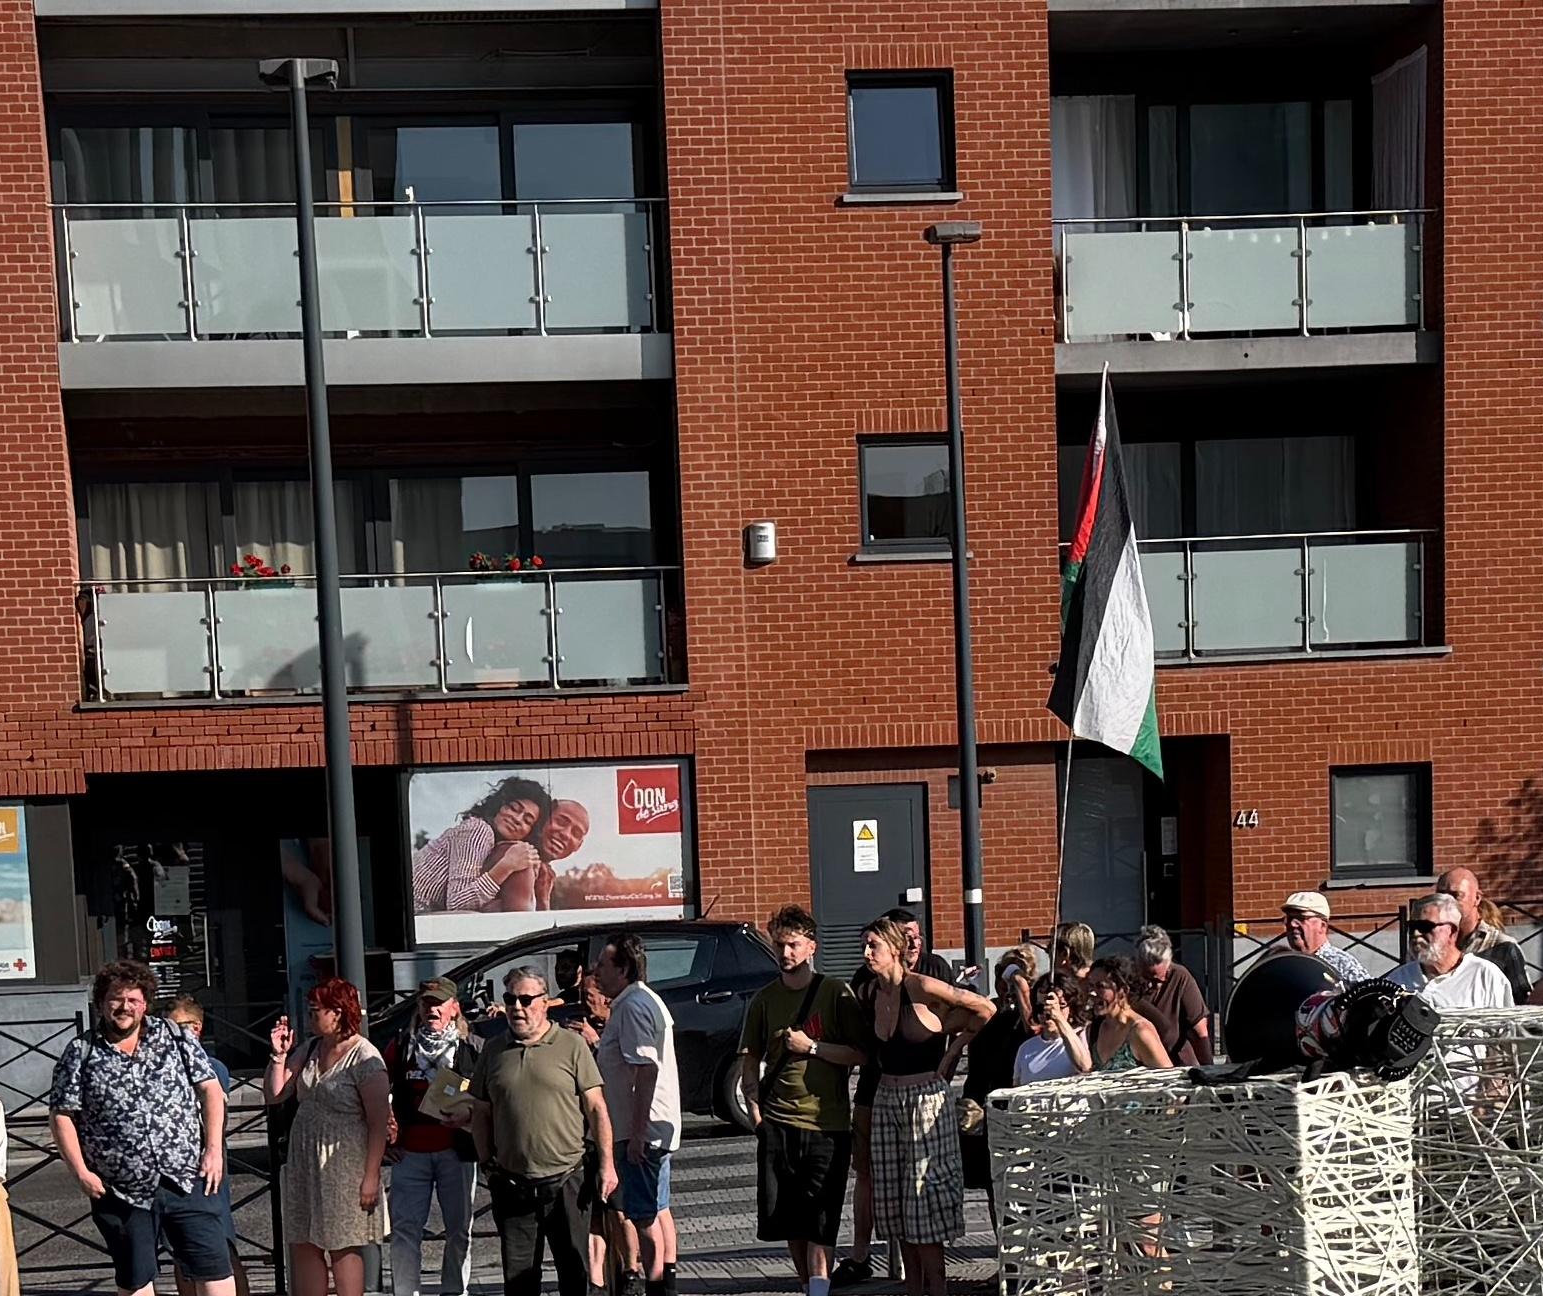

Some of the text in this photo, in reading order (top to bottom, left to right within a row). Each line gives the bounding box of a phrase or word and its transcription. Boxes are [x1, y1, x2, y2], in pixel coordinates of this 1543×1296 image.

[633, 787, 666, 809] DON
[635, 806, 650, 821] de
[1237, 808, 1259, 828] 44
